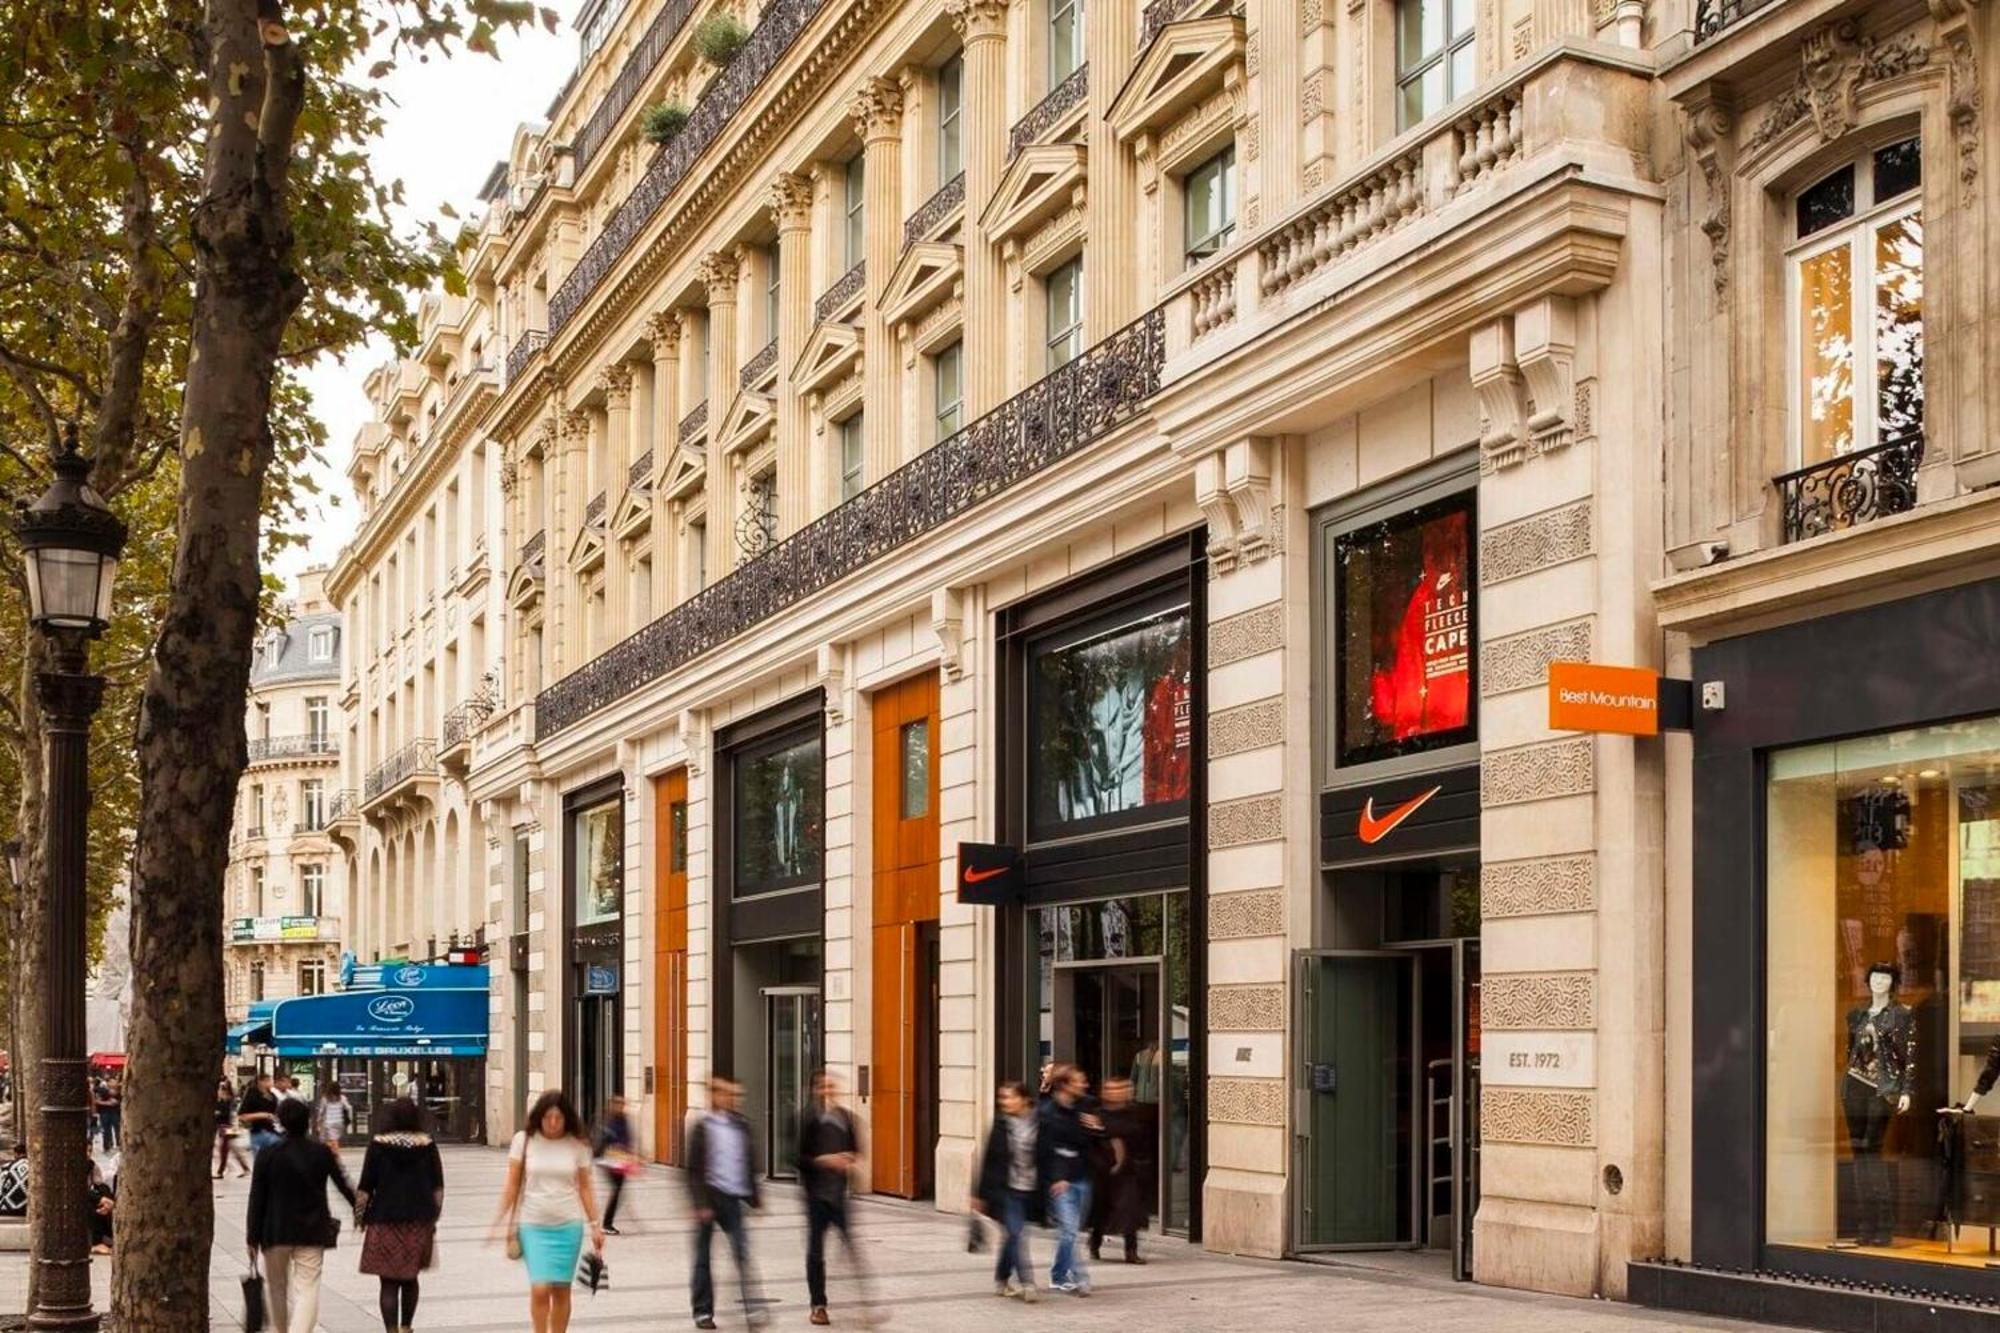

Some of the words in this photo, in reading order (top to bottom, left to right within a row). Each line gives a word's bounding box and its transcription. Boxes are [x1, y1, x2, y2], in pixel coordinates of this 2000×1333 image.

[1425, 590, 1468, 613] TECH
[1425, 609, 1468, 632] FLEECE
[1425, 629, 1468, 655] CAPE
[1560, 688, 1588, 704] Best
[1590, 690, 1656, 710] Mountain
[353, 1046, 373, 1055] DE
[375, 1046, 453, 1055] BRUXELLES
[1509, 1053, 1531, 1068] EST.
[1535, 1053, 1560, 1068] 1972
